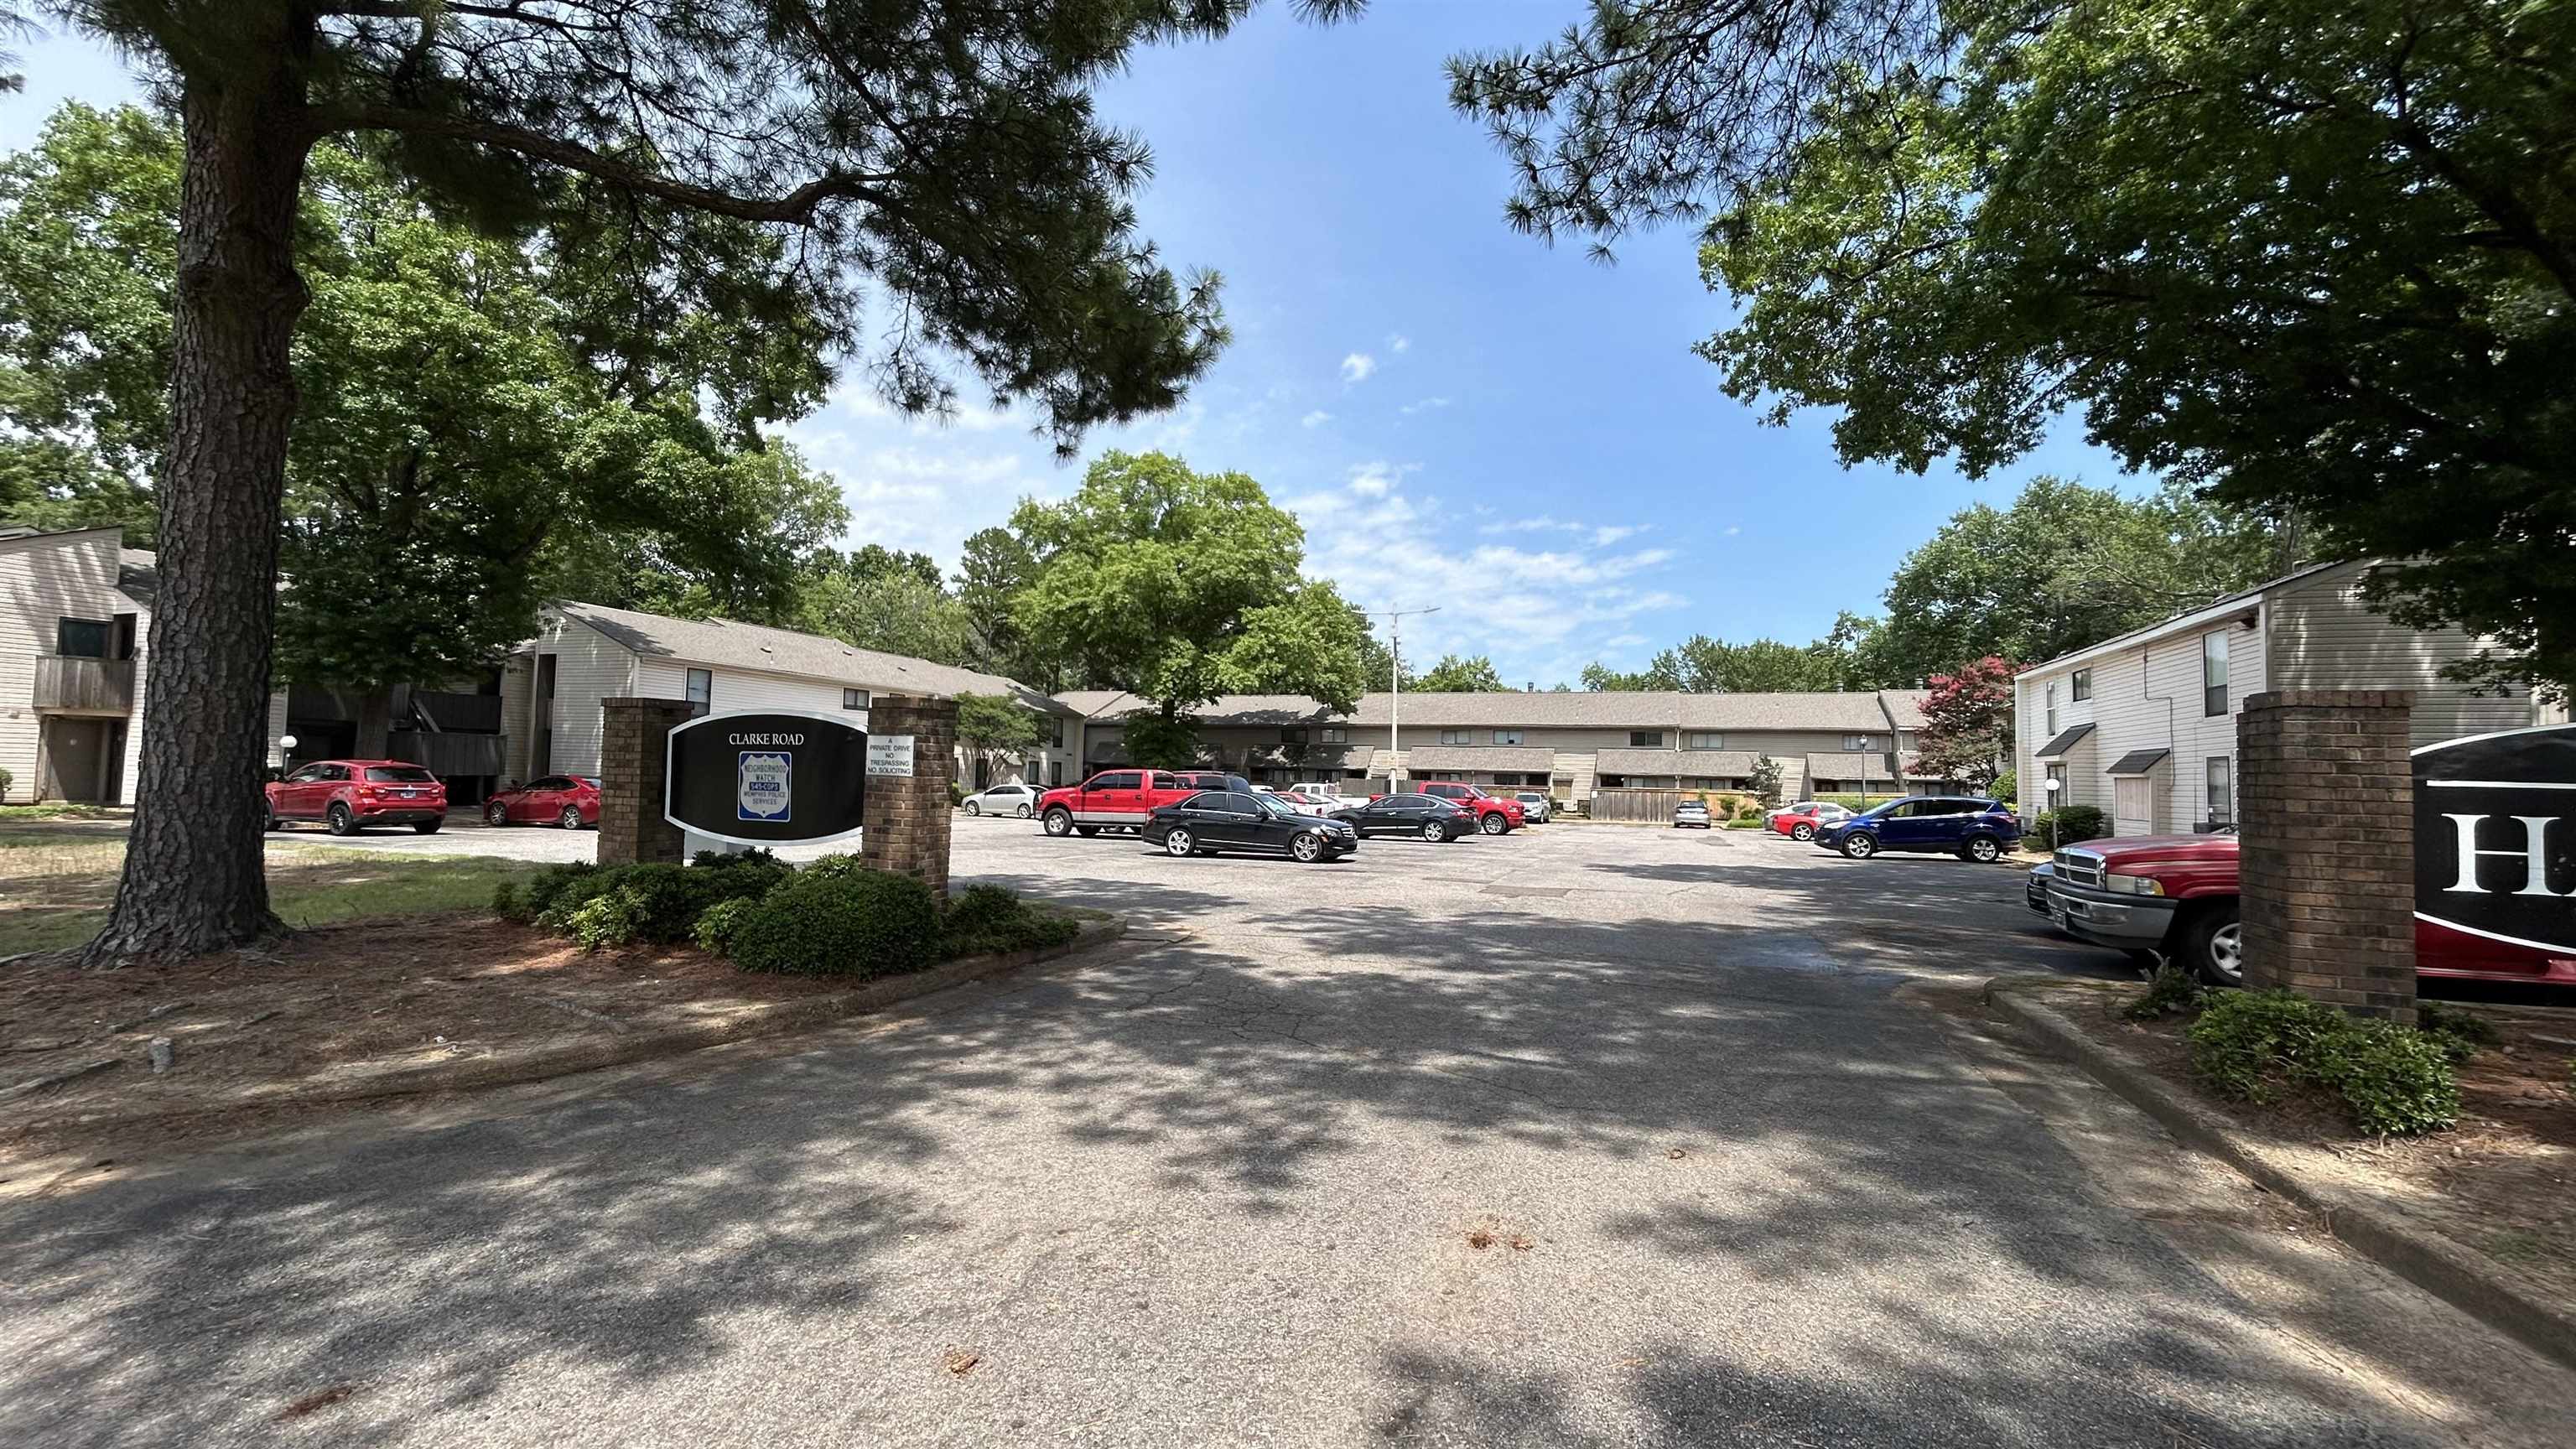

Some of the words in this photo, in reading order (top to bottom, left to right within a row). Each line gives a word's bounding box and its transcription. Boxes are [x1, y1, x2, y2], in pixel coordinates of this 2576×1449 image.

[729, 733, 770, 745] CLARKE
[772, 733, 804, 745] ROAD
[756, 773, 776, 782] WATCH
[2441, 813, 2576, 896] H
